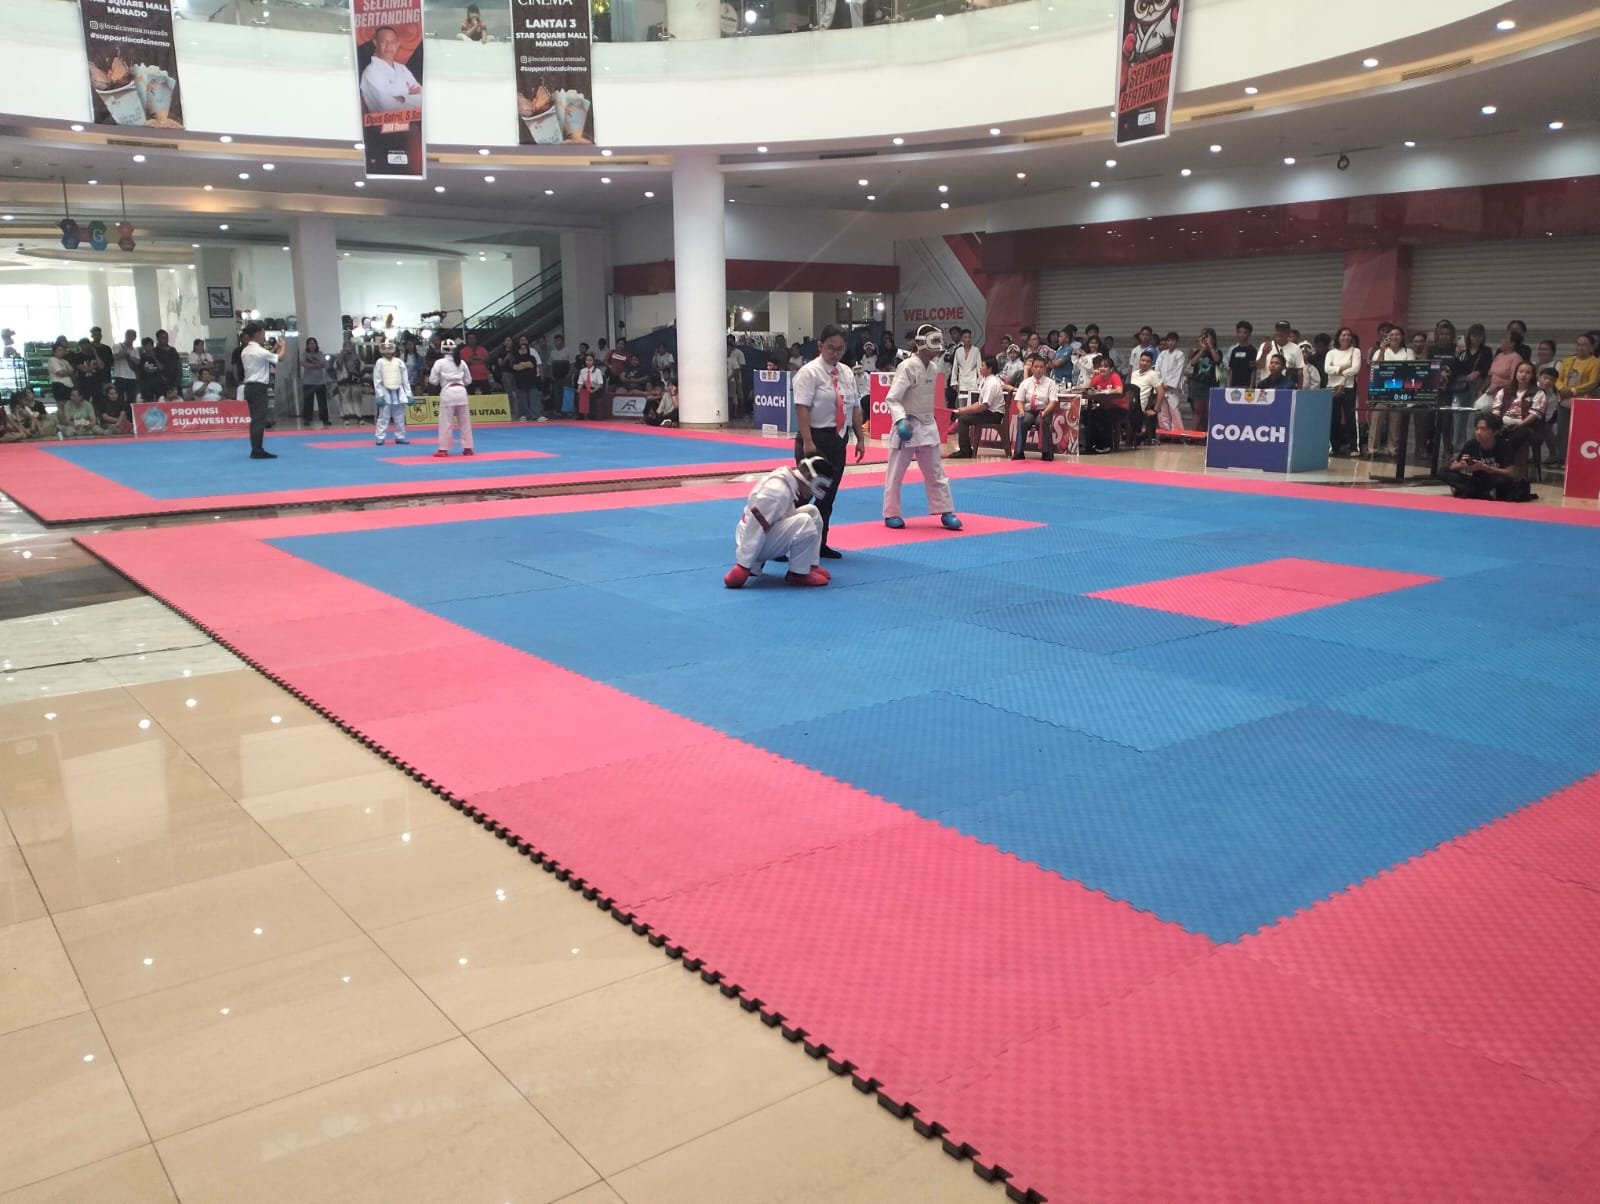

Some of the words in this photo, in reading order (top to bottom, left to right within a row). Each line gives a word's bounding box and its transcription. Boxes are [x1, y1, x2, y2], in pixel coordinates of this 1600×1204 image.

[145, 3, 169, 12] MALL
[107, 7, 148, 18] MANADO
[355, 9, 421, 28] BERTANDING
[526, 19, 567, 28] LANTAI
[569, 19, 577, 28] 3
[536, 32, 566, 40] SQUARE
[904, 307, 964, 321] WELCOME
[755, 395, 786, 408] COACH
[171, 407, 218, 416] PROVINSI
[479, 408, 507, 416] UTARA
[173, 417, 224, 426] SULAWESI
[1211, 424, 1286, 443] COACH
